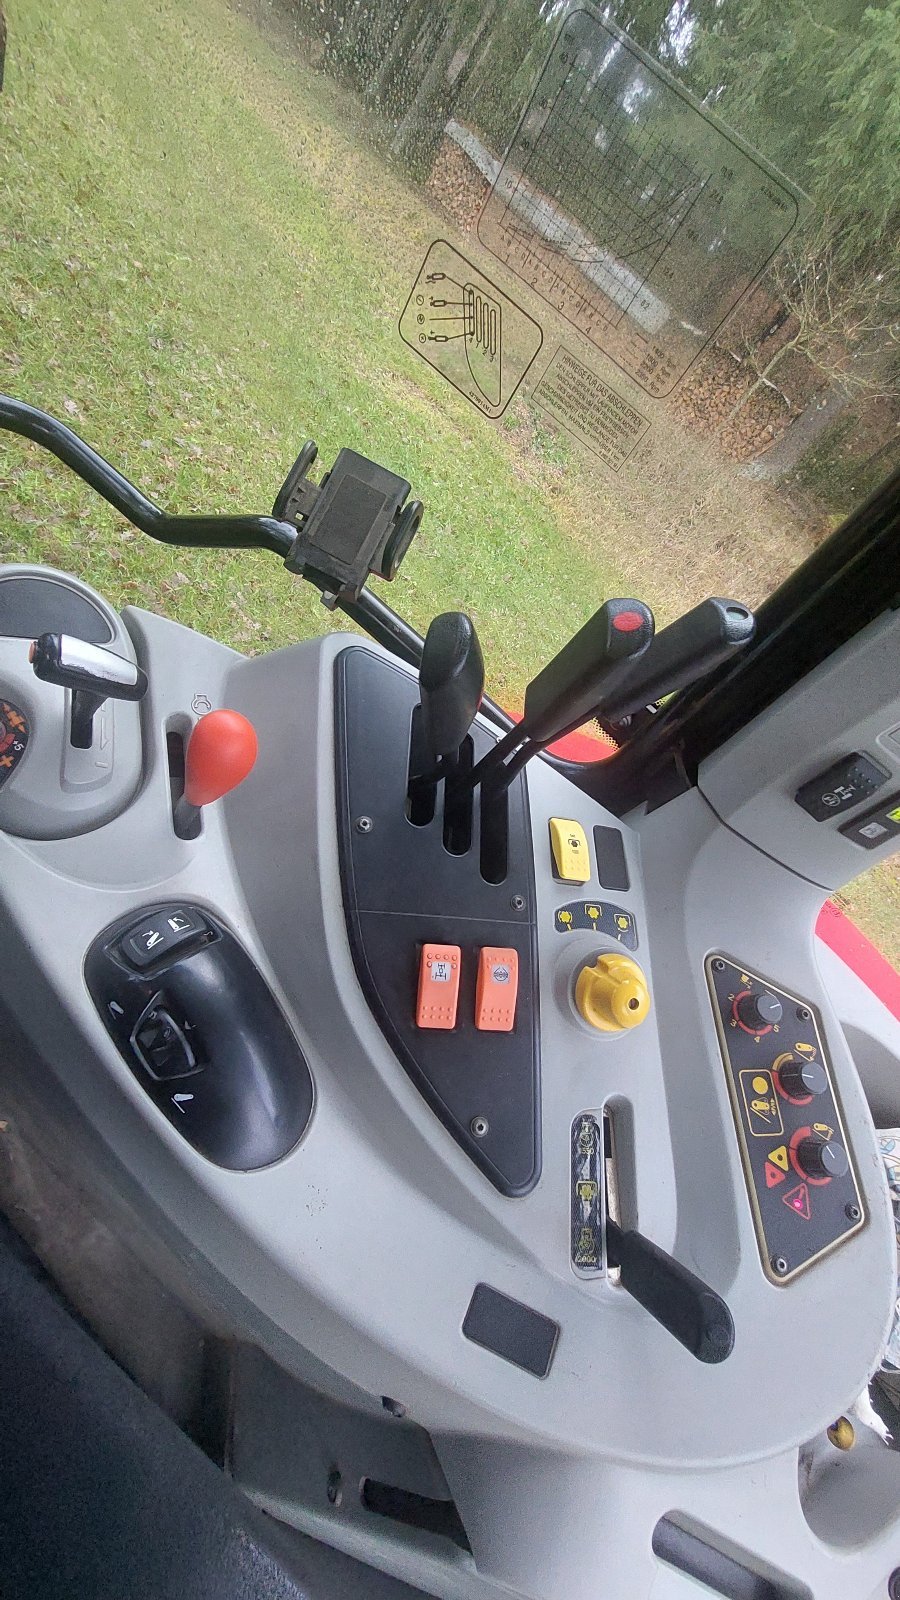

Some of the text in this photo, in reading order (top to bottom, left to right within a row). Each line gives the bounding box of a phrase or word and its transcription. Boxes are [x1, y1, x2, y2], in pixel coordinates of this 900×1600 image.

[503, 253, 591, 334] 1 2 3 4
[562, 354, 586, 378] HINWEISE
[596, 384, 607, 397] DAS
[606, 393, 642, 426] ABSCHLEPPEN
[555, 362, 565, 373] DEN
[621, 419, 637, 435] MOTOR
[577, 412, 587, 422] UND
[728, 994, 735, 1002] 2
[730, 1018, 737, 1027] 3
[773, 1024, 780, 1032] 5
